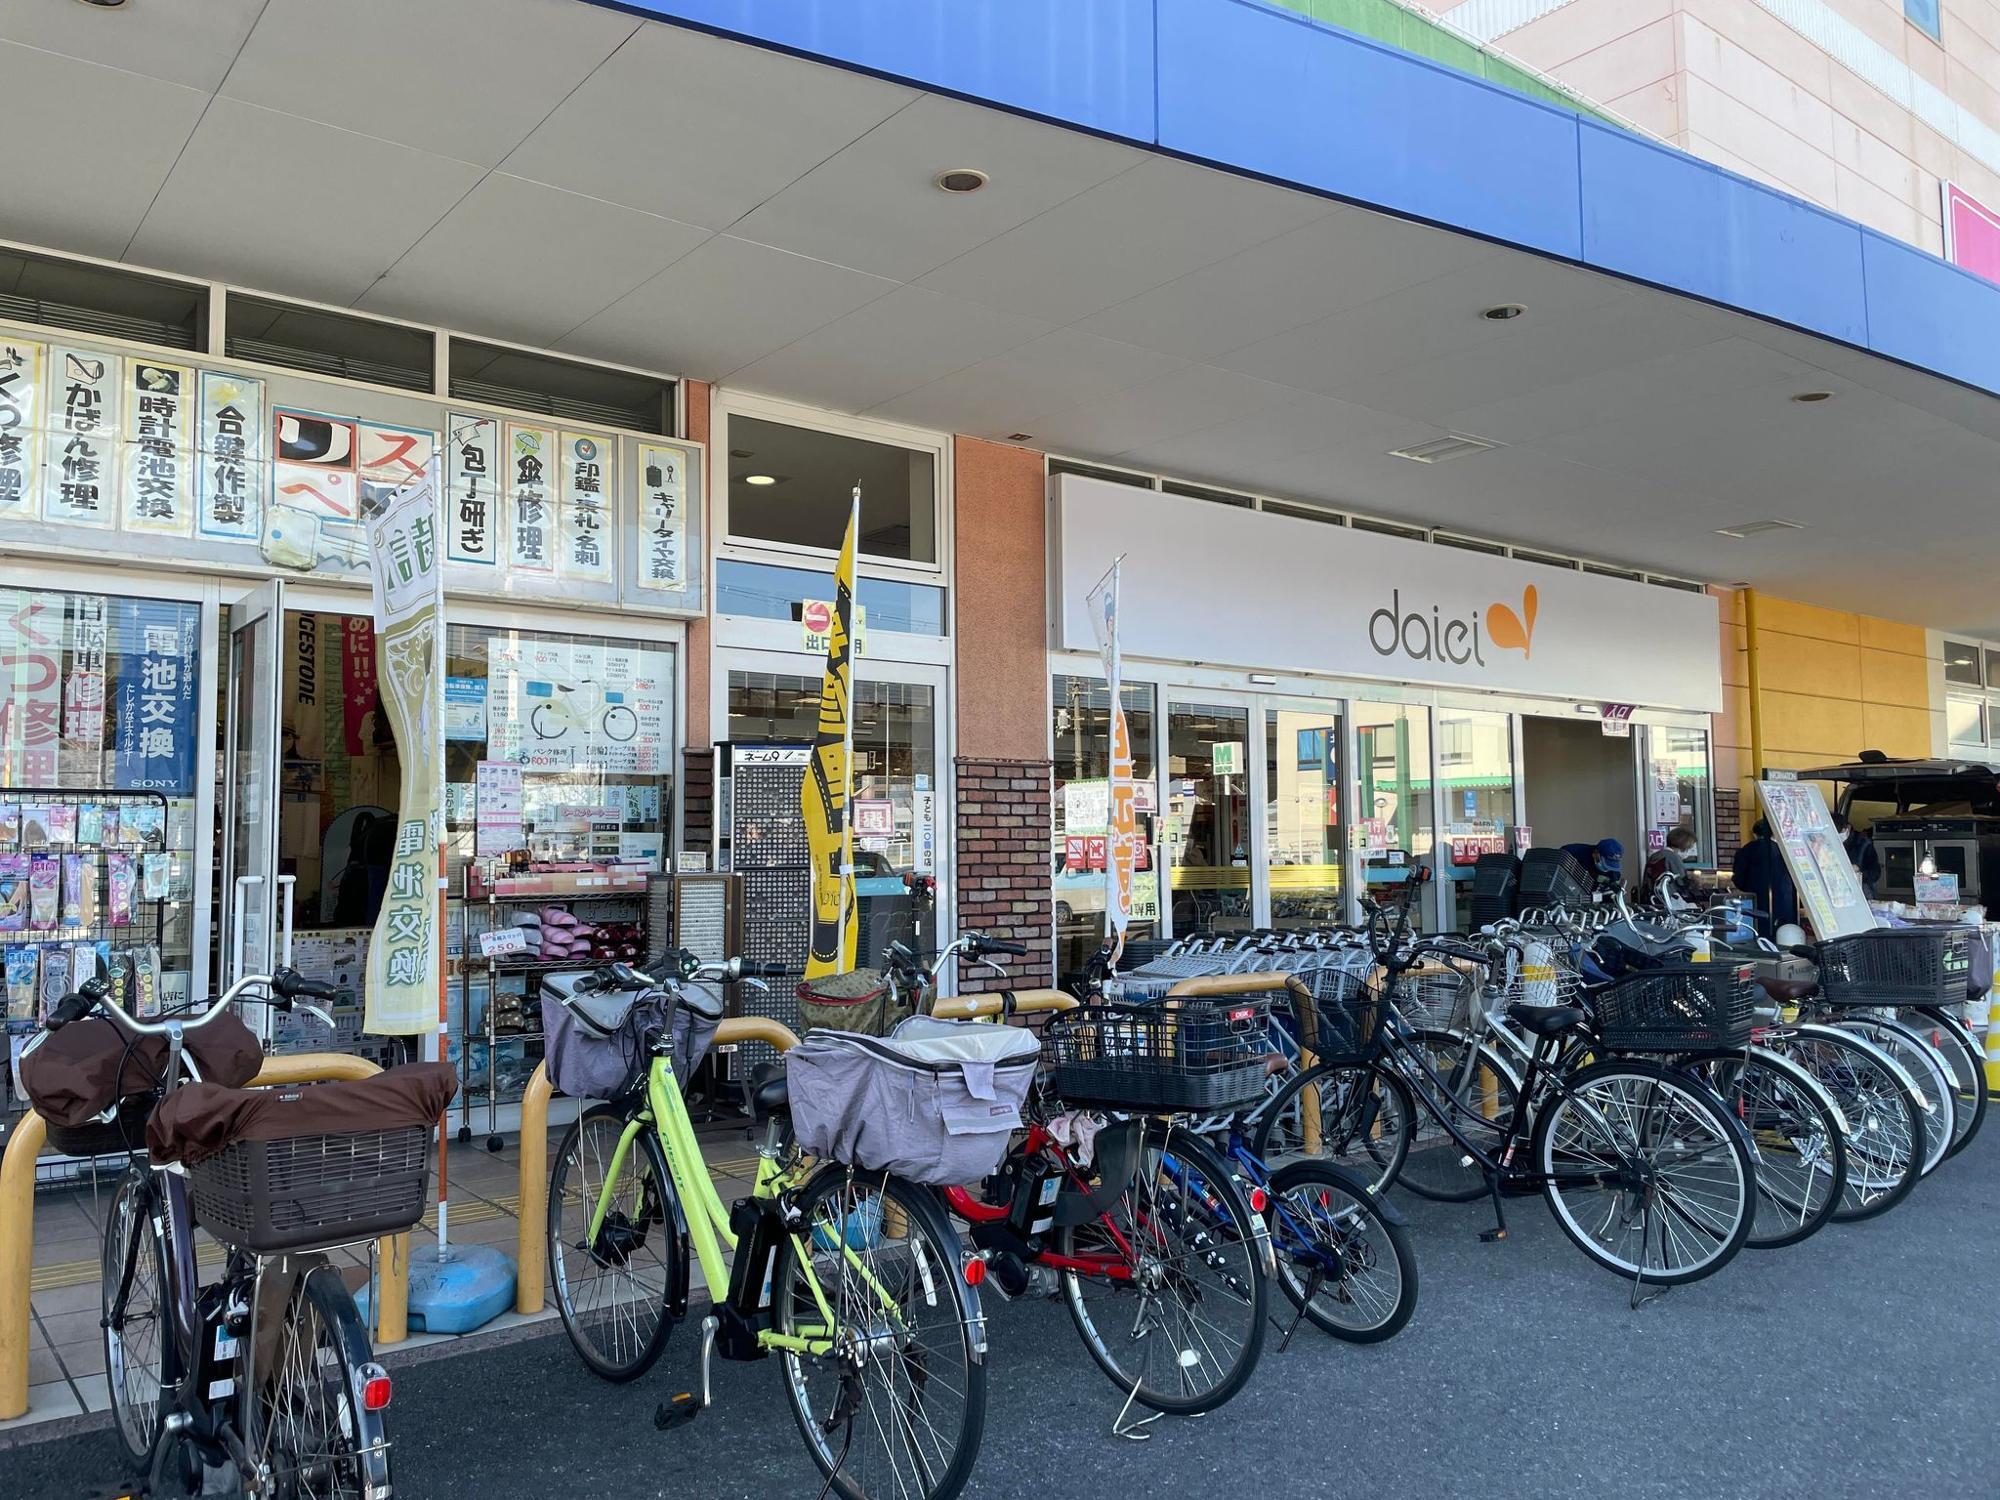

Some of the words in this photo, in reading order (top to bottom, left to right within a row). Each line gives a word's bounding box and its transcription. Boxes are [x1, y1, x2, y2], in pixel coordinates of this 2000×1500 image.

[60, 383, 102, 511] かばん修理
[137, 396, 177, 519] 時計電池交換
[214, 405, 246, 526] 合鍵作製
[459, 444, 486, 553] 包丁研ぎ
[516, 454, 544, 561] 傘修理
[574, 462, 600, 567] 印鑑・表札・名刺
[651, 492, 676, 580] キャリータイヤ交換
[1368, 588, 1485, 668] daiei
[139, 625, 179, 759] 電池交換
[1606, 704, 1629, 719] 入口
[130, 778, 179, 789] SONY
